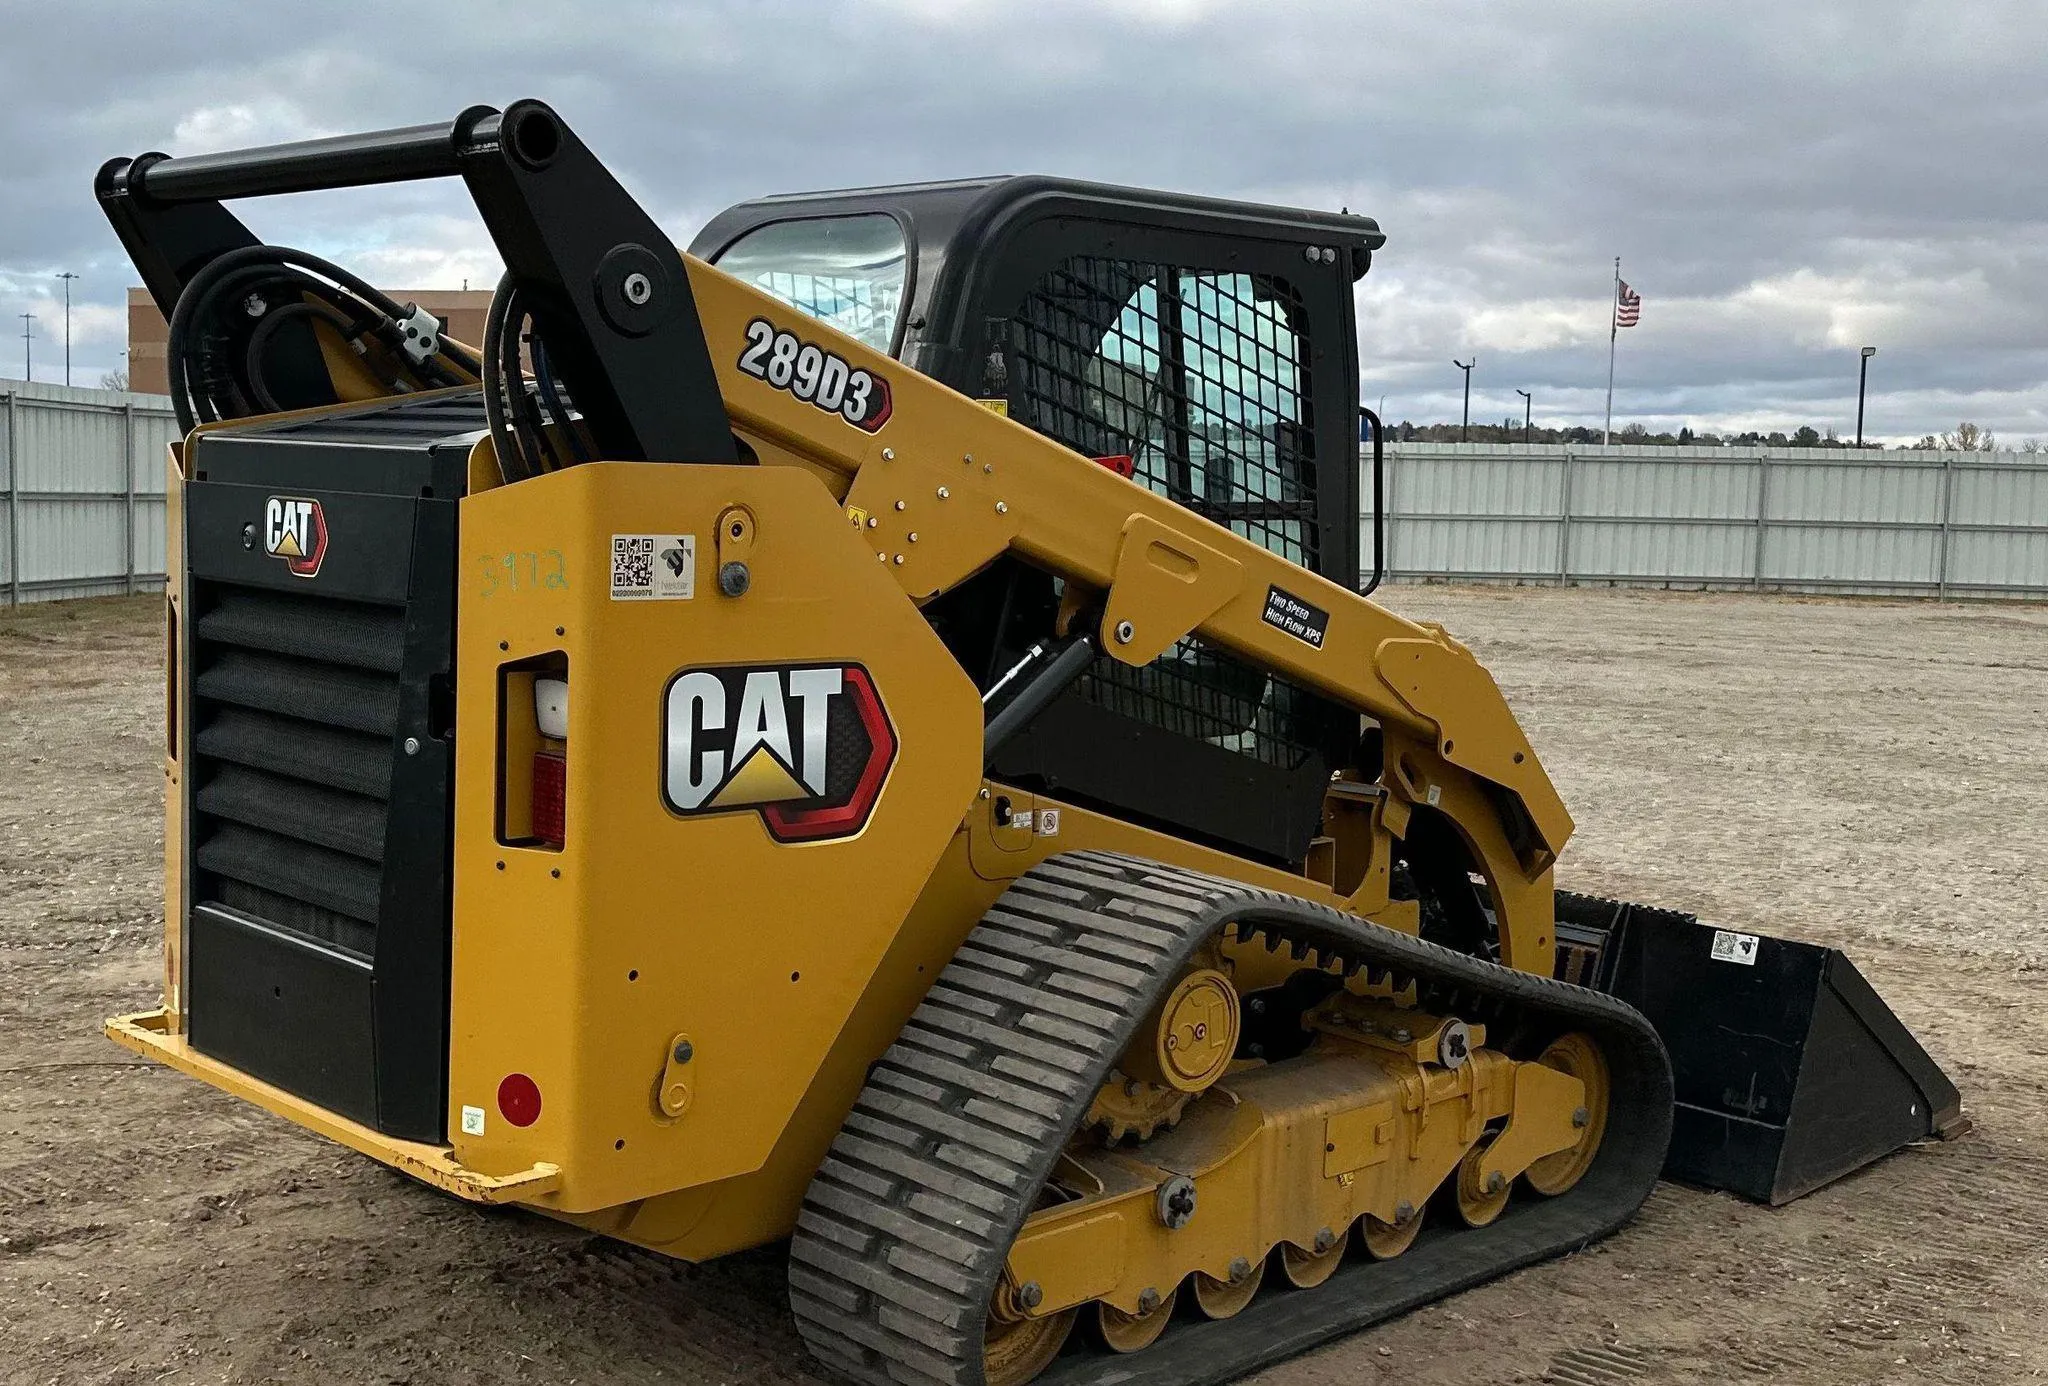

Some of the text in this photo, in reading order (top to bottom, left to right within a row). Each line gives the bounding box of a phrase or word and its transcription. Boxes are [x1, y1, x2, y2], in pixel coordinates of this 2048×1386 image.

[740, 321, 873, 421] 289D3
[266, 499, 312, 556] CAT
[1304, 626, 1322, 643] XPS
[668, 668, 842, 810] CAT
